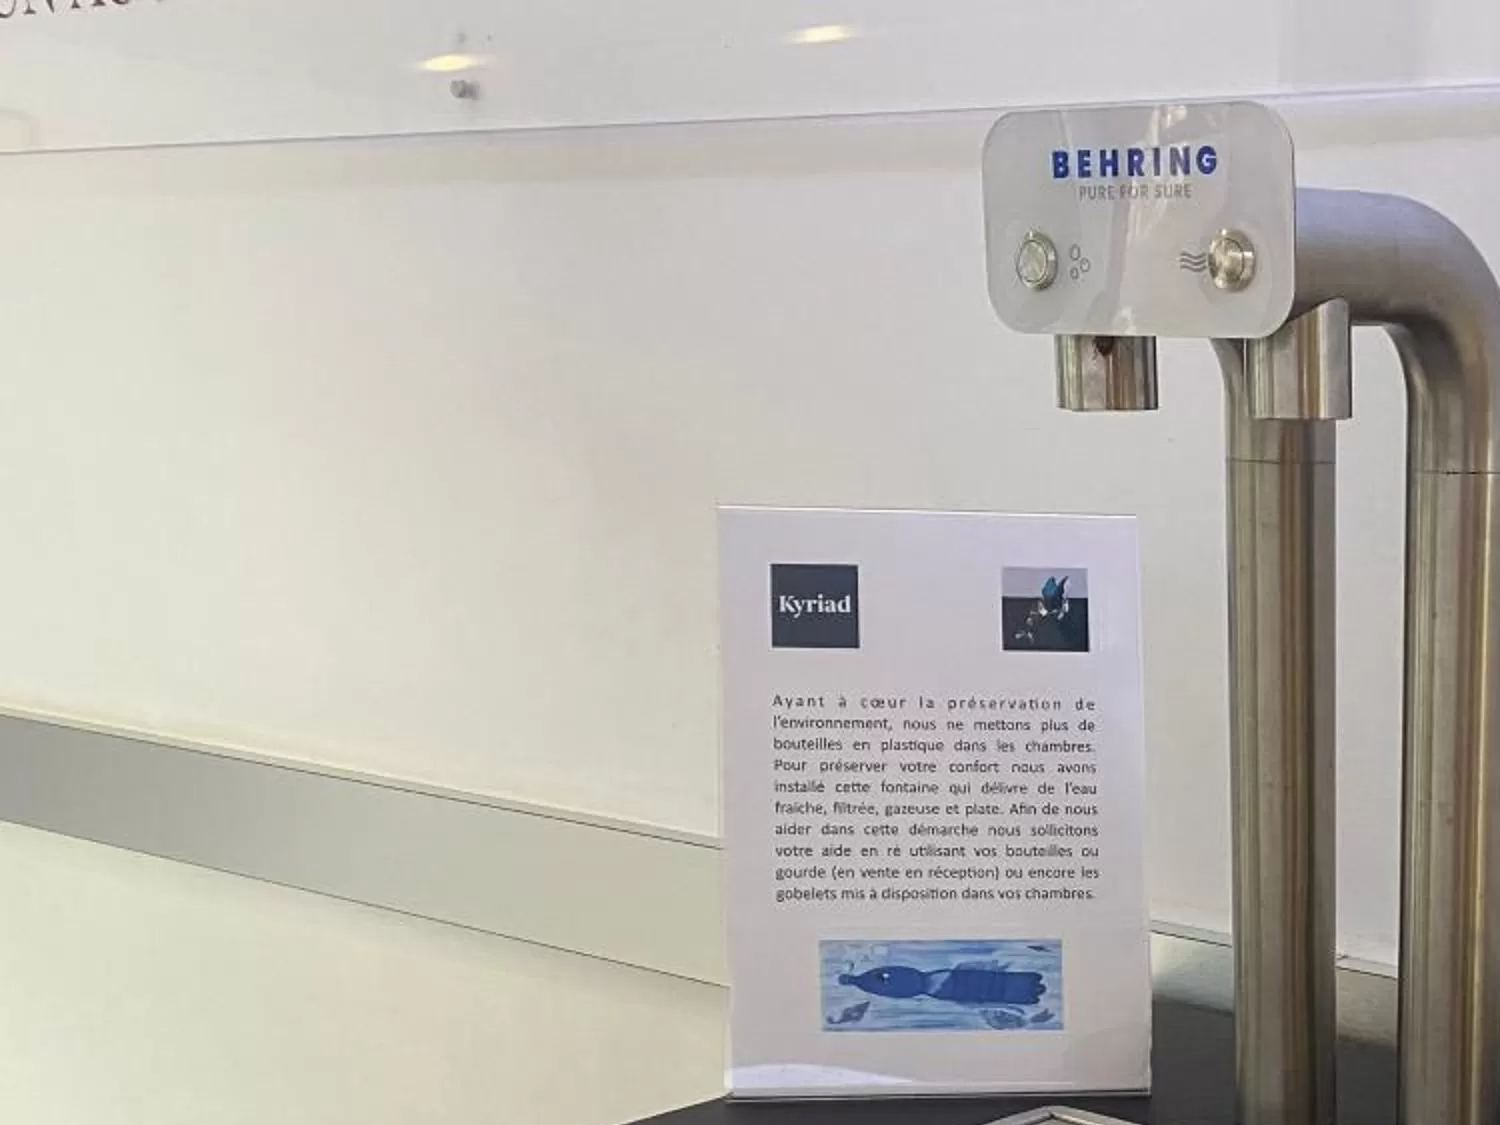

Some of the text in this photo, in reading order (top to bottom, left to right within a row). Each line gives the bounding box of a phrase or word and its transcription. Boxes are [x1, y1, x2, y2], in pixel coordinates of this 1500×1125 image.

[1052, 145, 1217, 179] BEHRING
[1079, 183, 1193, 200] PURE FOR SURE
[779, 593, 851, 618] Kyriad
[771, 693, 1096, 712] Ayant à cœur la préservation de
[902, 719, 937, 731] nous
[946, 720, 965, 731] ne
[973, 719, 1031, 732] mettons
[1040, 718, 1069, 735] plus
[1077, 718, 1096, 733] de
[773, 736, 1096, 754] bouteilles en plastique dans les chambres.
[773, 758, 1097, 774] Pour préserver votre confort nous avons
[774, 779, 1097, 797] installé cette fontaine qui délivre de l'eau
[832, 801, 880, 817] filtrée,
[884, 804, 941, 818] gazeuse
[945, 803, 960, 815] et
[1009, 801, 1037, 816] Afin
[1041, 801, 1060, 816] de
[1064, 804, 1099, 816] nous
[775, 821, 1099, 838] aider dans cette démarche nous sollicitons
[775, 843, 1099, 859] votre aide en ré utilisant vos bouteilles ou
[775, 864, 1100, 882] gourde (en vente en réception) ou encore les
[775, 886, 1096, 903] gobelets mis à disposition dans vos chambres.
